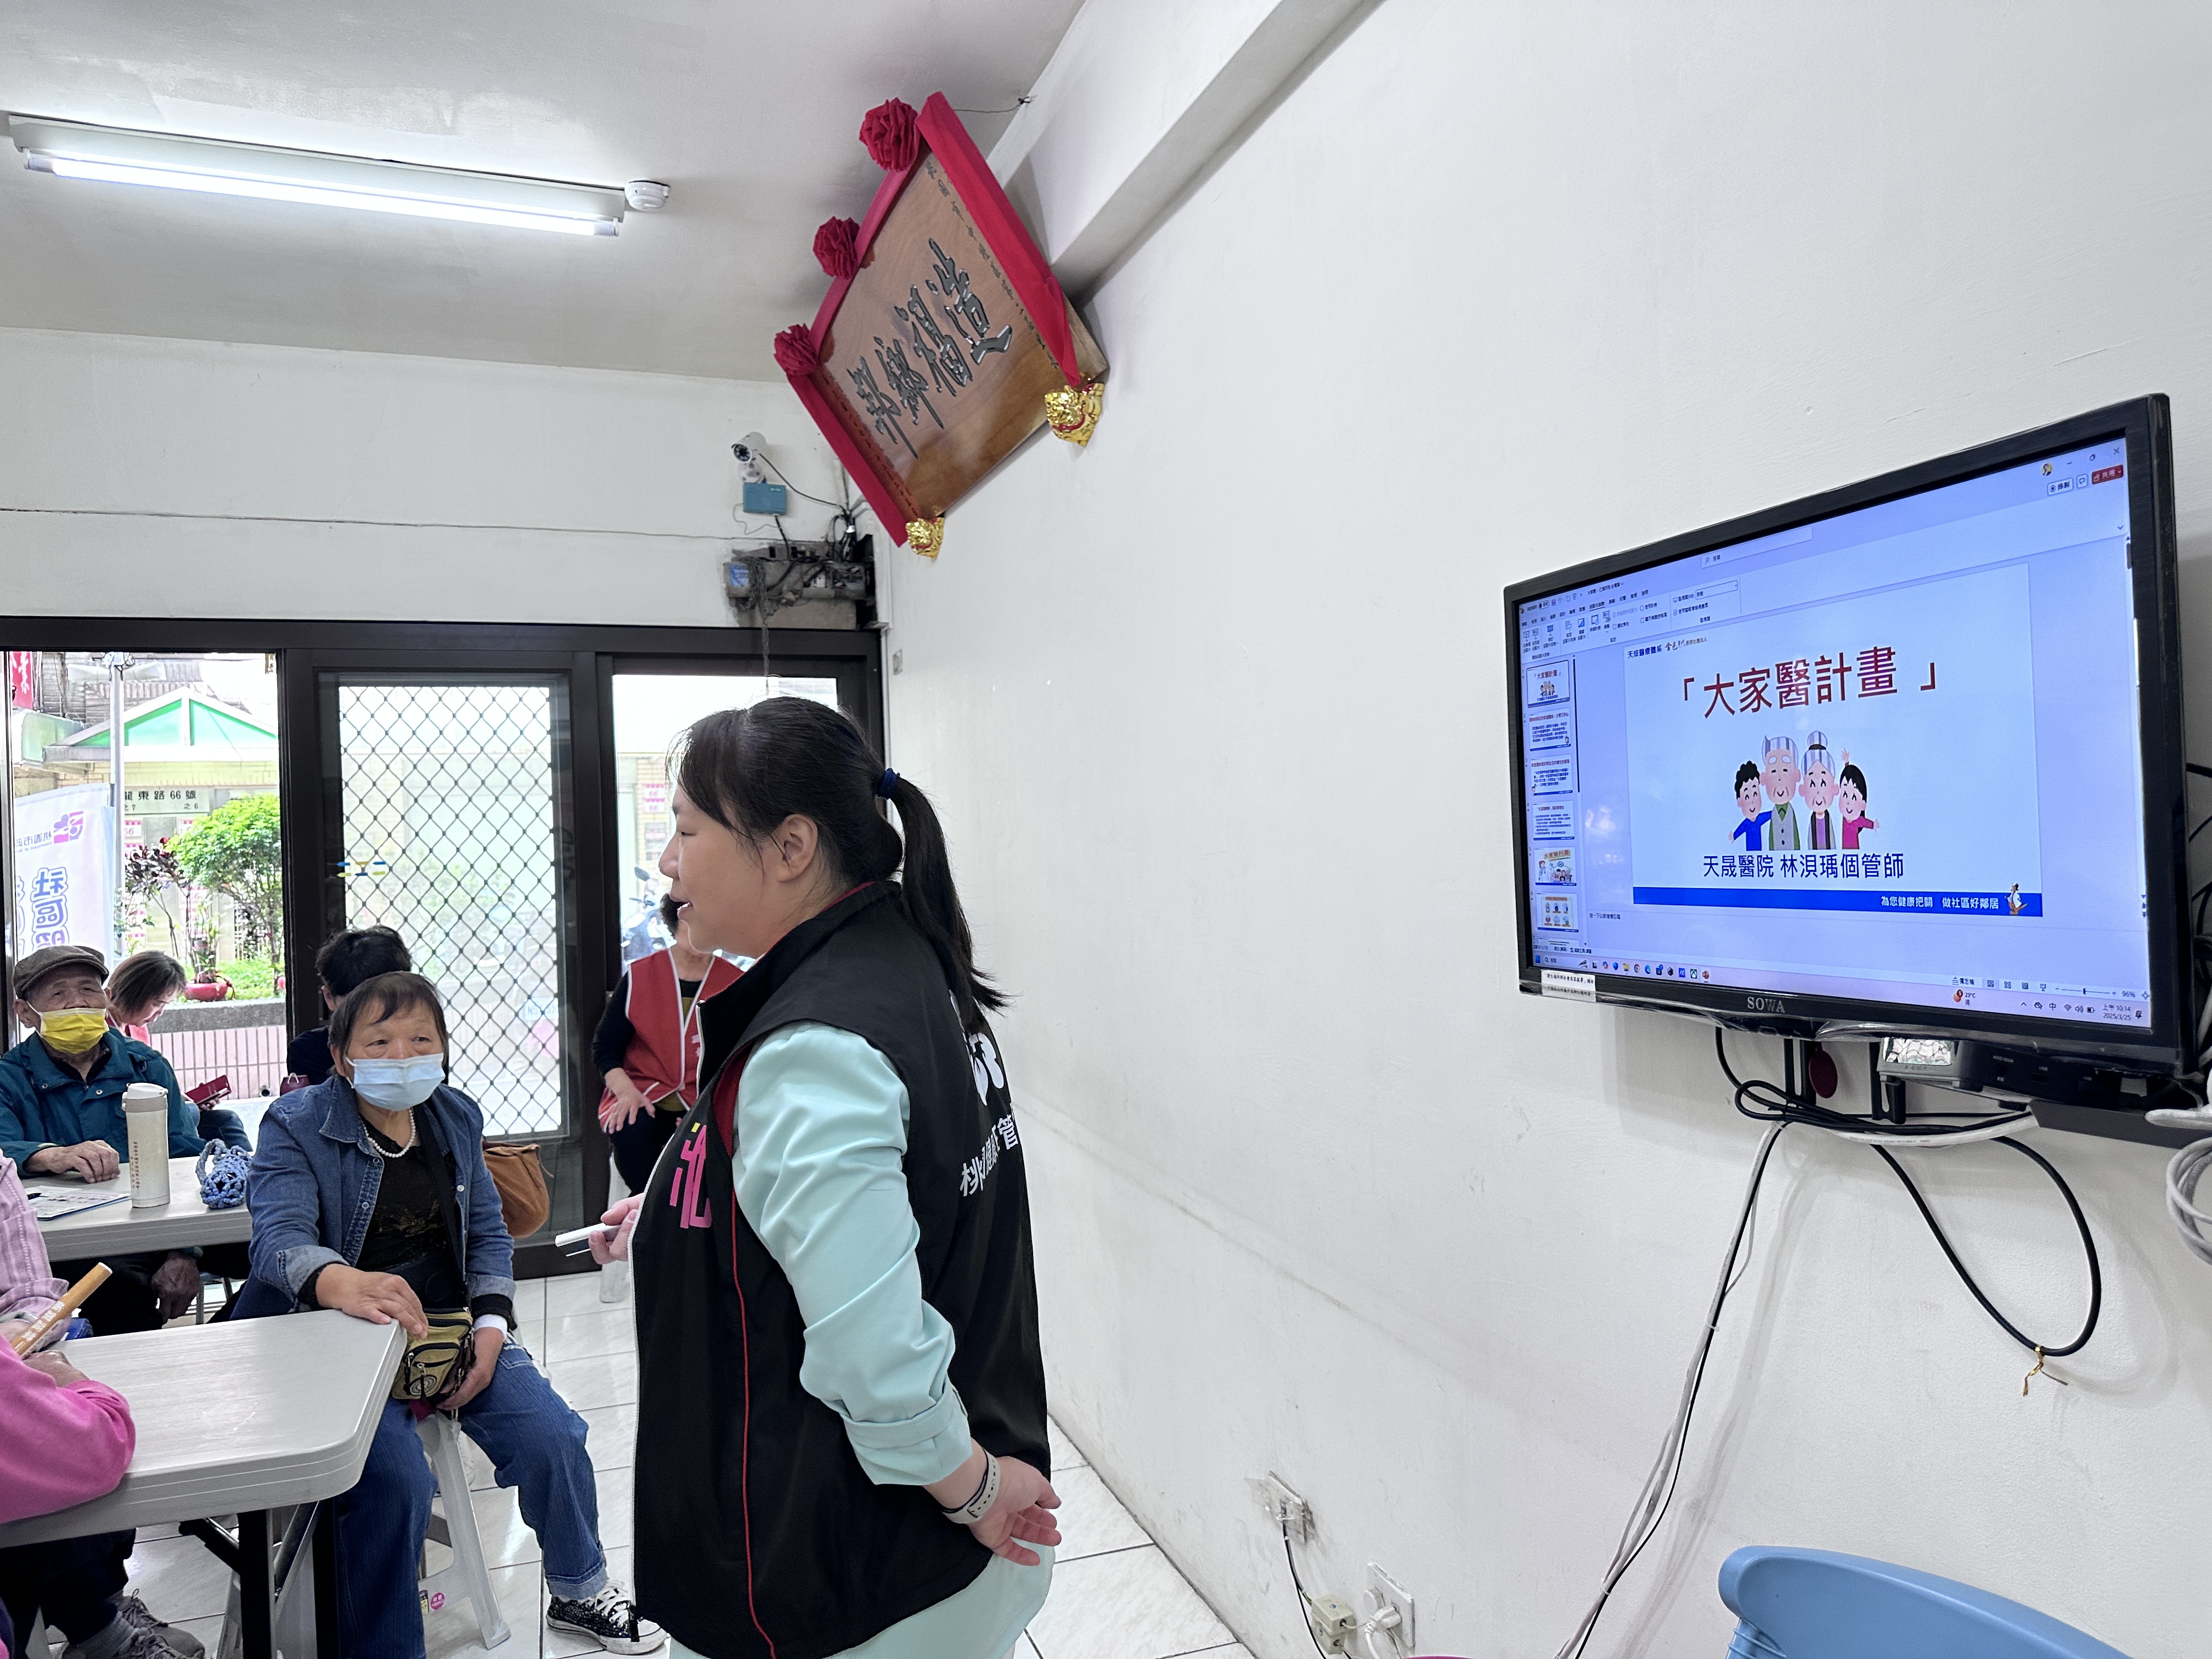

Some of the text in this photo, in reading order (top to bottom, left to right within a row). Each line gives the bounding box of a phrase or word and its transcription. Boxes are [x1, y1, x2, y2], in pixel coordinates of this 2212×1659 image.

[1703, 854, 1774, 878] 天晟醫院
[1881, 896, 1933, 908] 為您健康把關
[1747, 996, 1786, 1014] SOWA
[2103, 1012, 2131, 1020] 2025/3/25
